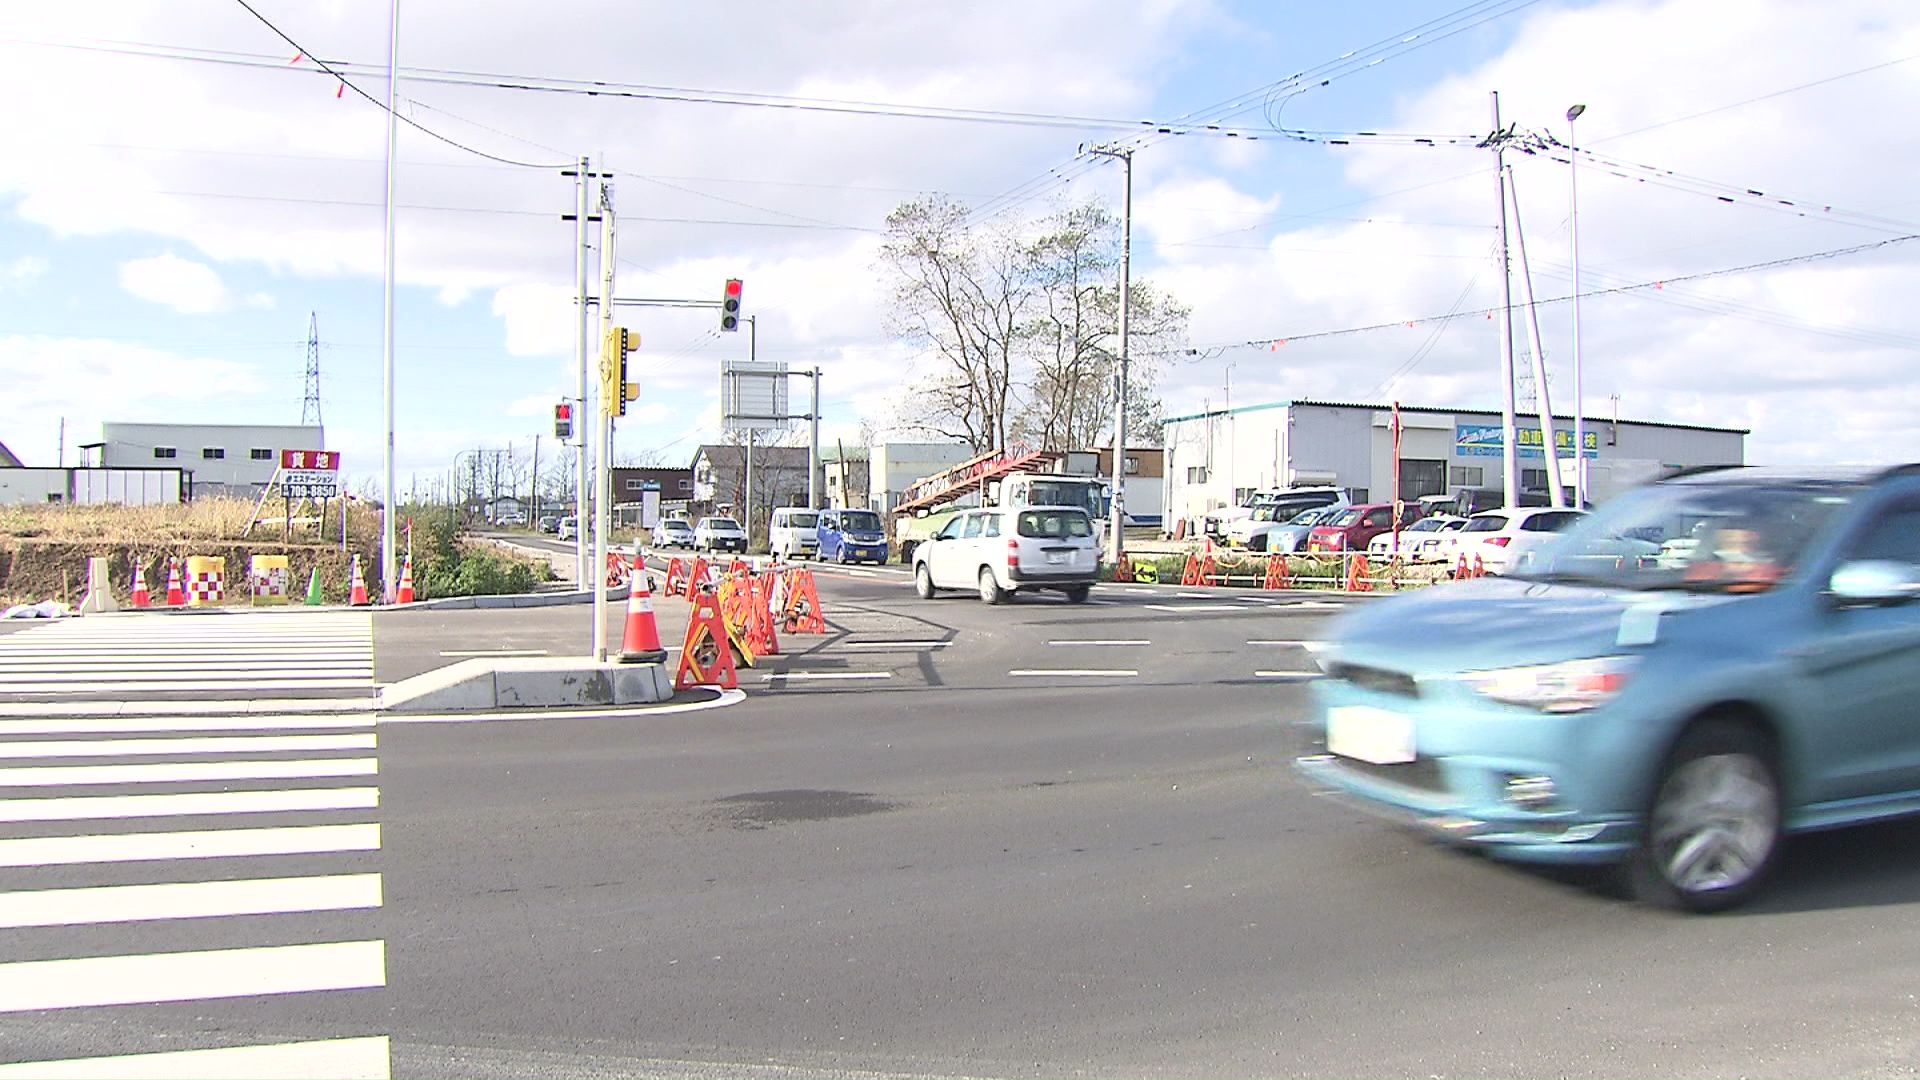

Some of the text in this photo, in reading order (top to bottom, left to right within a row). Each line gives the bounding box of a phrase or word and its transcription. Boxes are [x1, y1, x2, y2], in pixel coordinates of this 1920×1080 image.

[1517, 429, 1597, 448] 動車備・検
[291, 451, 329, 469] 貸地
[293, 475, 333, 484] エステーション
